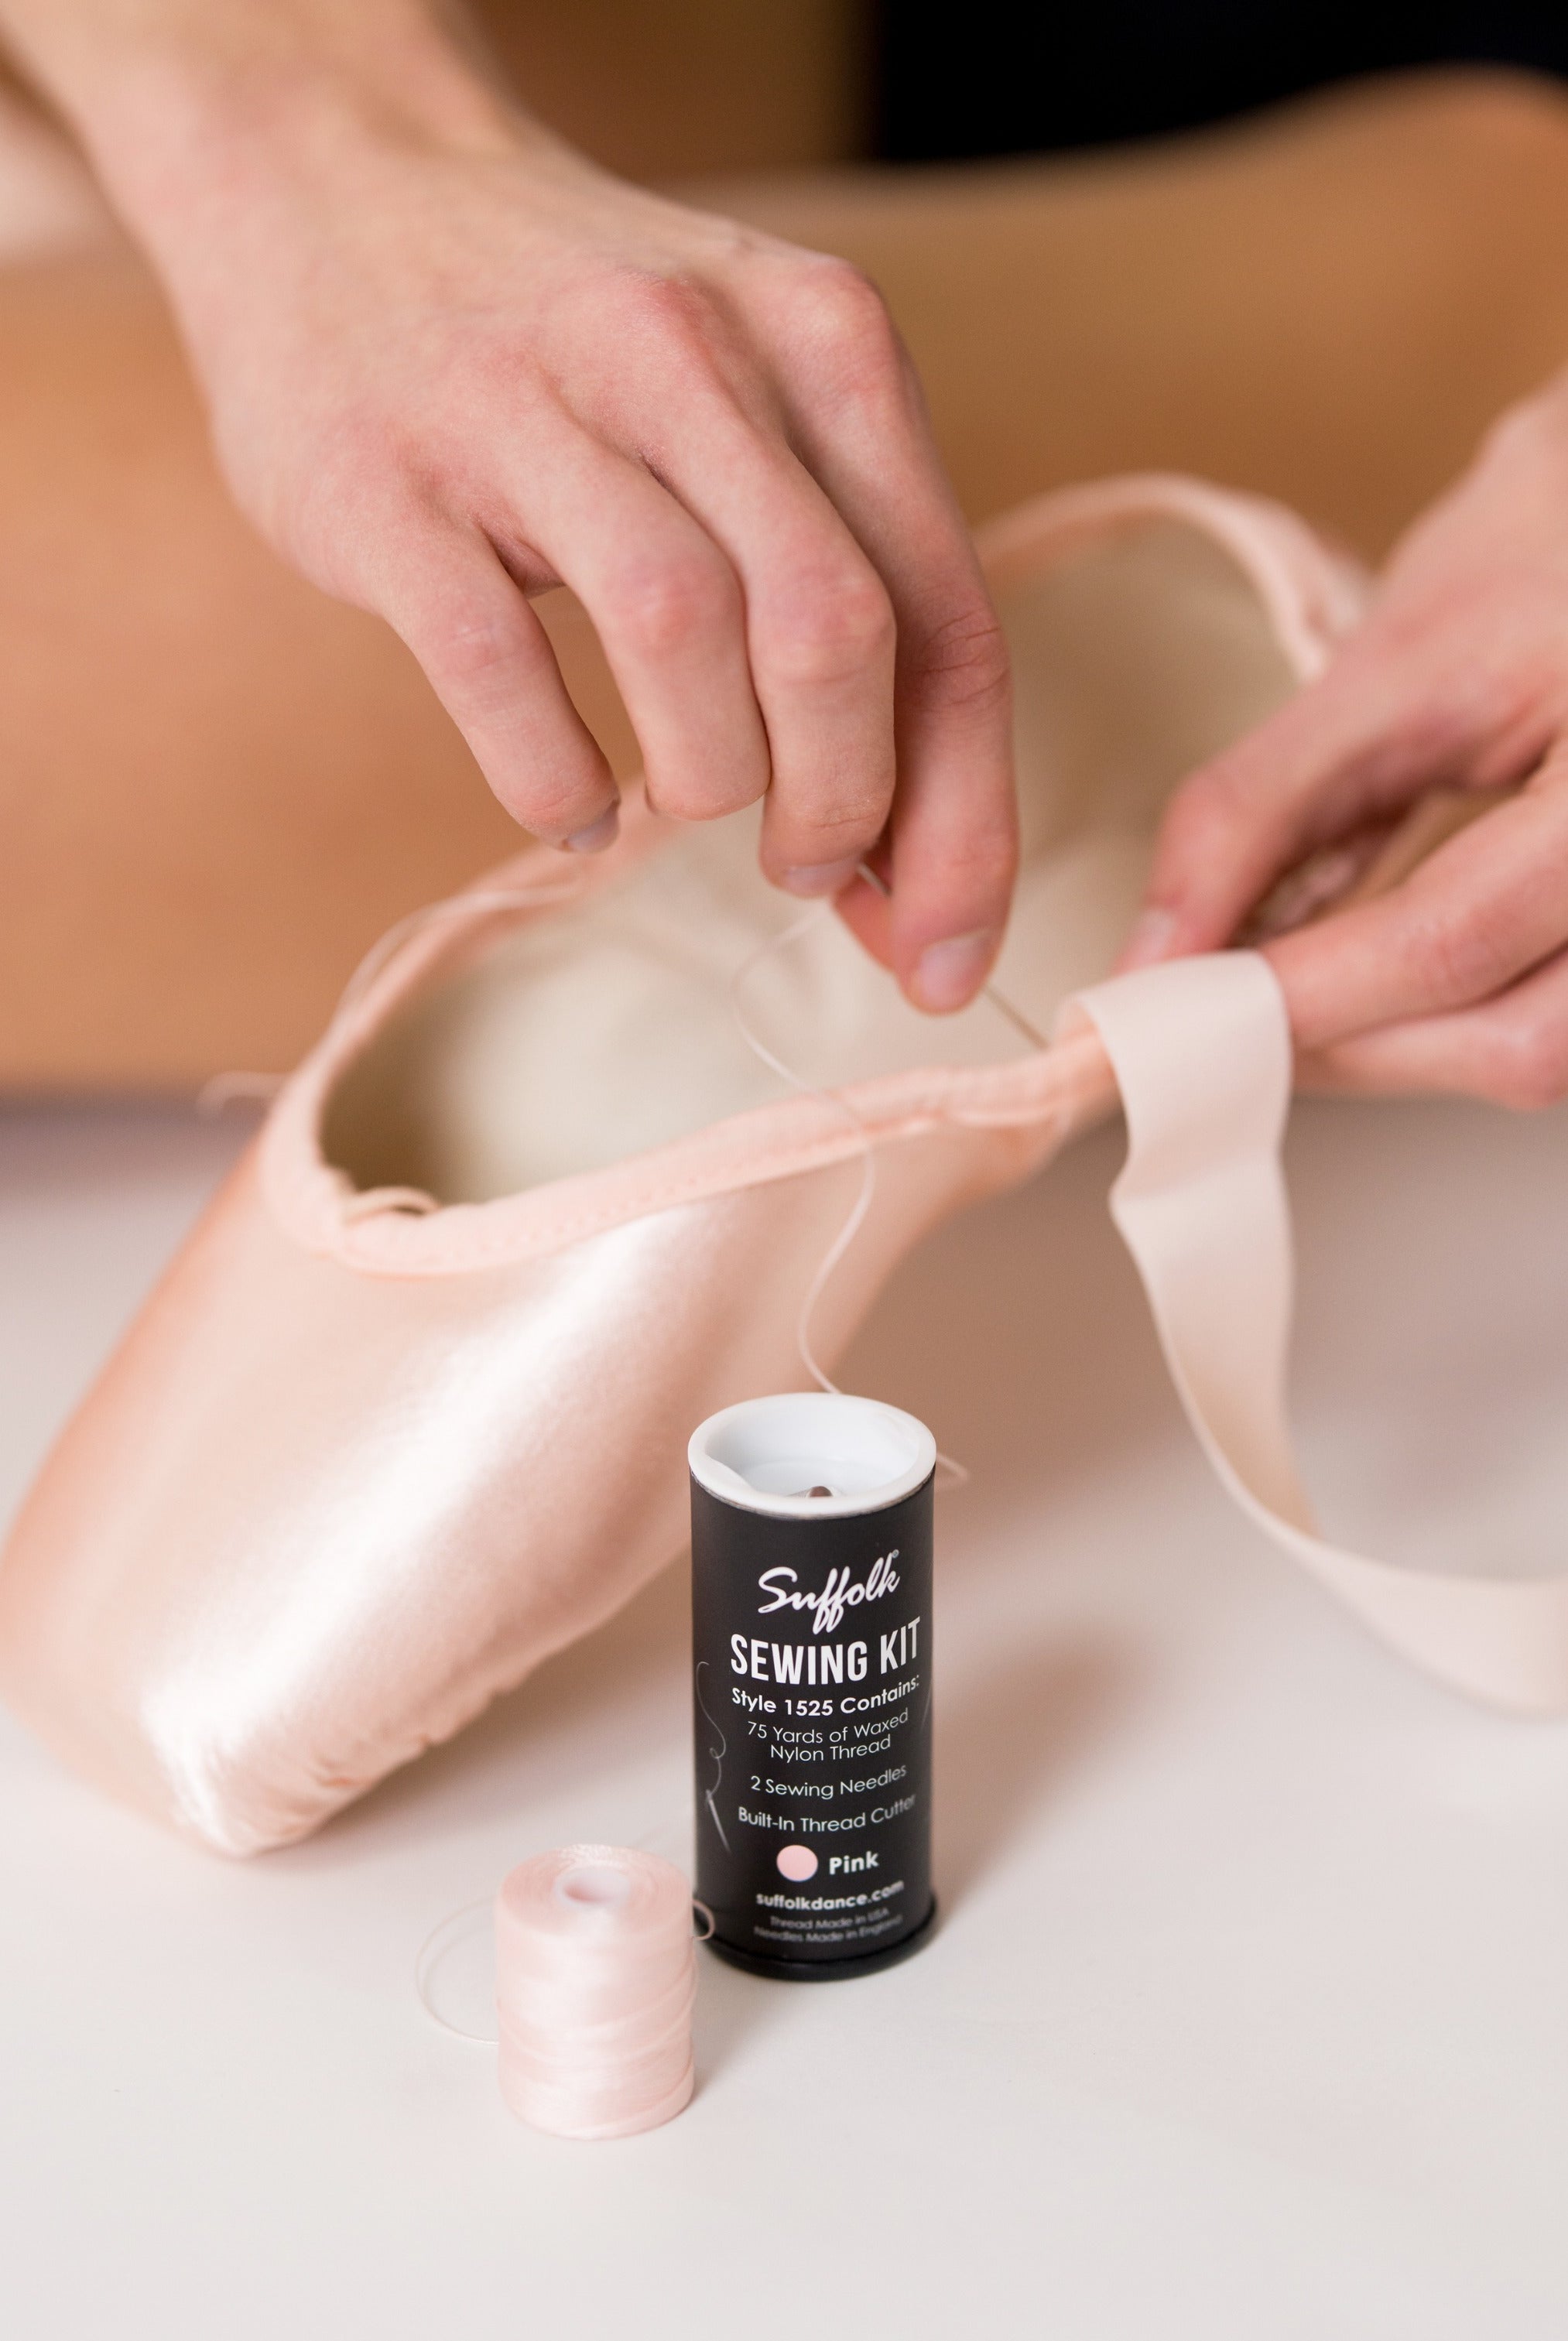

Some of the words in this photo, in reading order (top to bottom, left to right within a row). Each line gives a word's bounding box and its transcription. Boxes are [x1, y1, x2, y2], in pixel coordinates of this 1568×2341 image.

[758, 1552, 900, 1634] Suffolk
[731, 1634, 868, 1685] SEWING
[880, 1616, 921, 1675] KIT
[731, 1687, 777, 1713] Style
[784, 1699, 834, 1716] 1525
[840, 1675, 920, 1714] Contains:
[747, 1720, 767, 1739] 75
[772, 1726, 823, 1744] Yards
[829, 1727, 848, 1742] of
[854, 1707, 909, 1738] Waxed
[770, 1744, 824, 1764] Nylon
[830, 1734, 891, 1760] Thread
[750, 1775, 762, 1791] 2
[765, 1779, 834, 1800] Sewing
[840, 1764, 907, 1795] Needles
[738, 1806, 795, 1832] Built-In
[800, 1812, 866, 1833] Thread
[871, 1793, 917, 1824] Cutter
[829, 1850, 880, 1875] Pink
[755, 1881, 905, 1911] suffolkdance.com
[769, 1915, 813, 1930] Thread
[815, 1916, 852, 1930] Made
[854, 1913, 866, 1925] in
[867, 1907, 889, 1921] USA
[806, 1929, 844, 1942] Made
